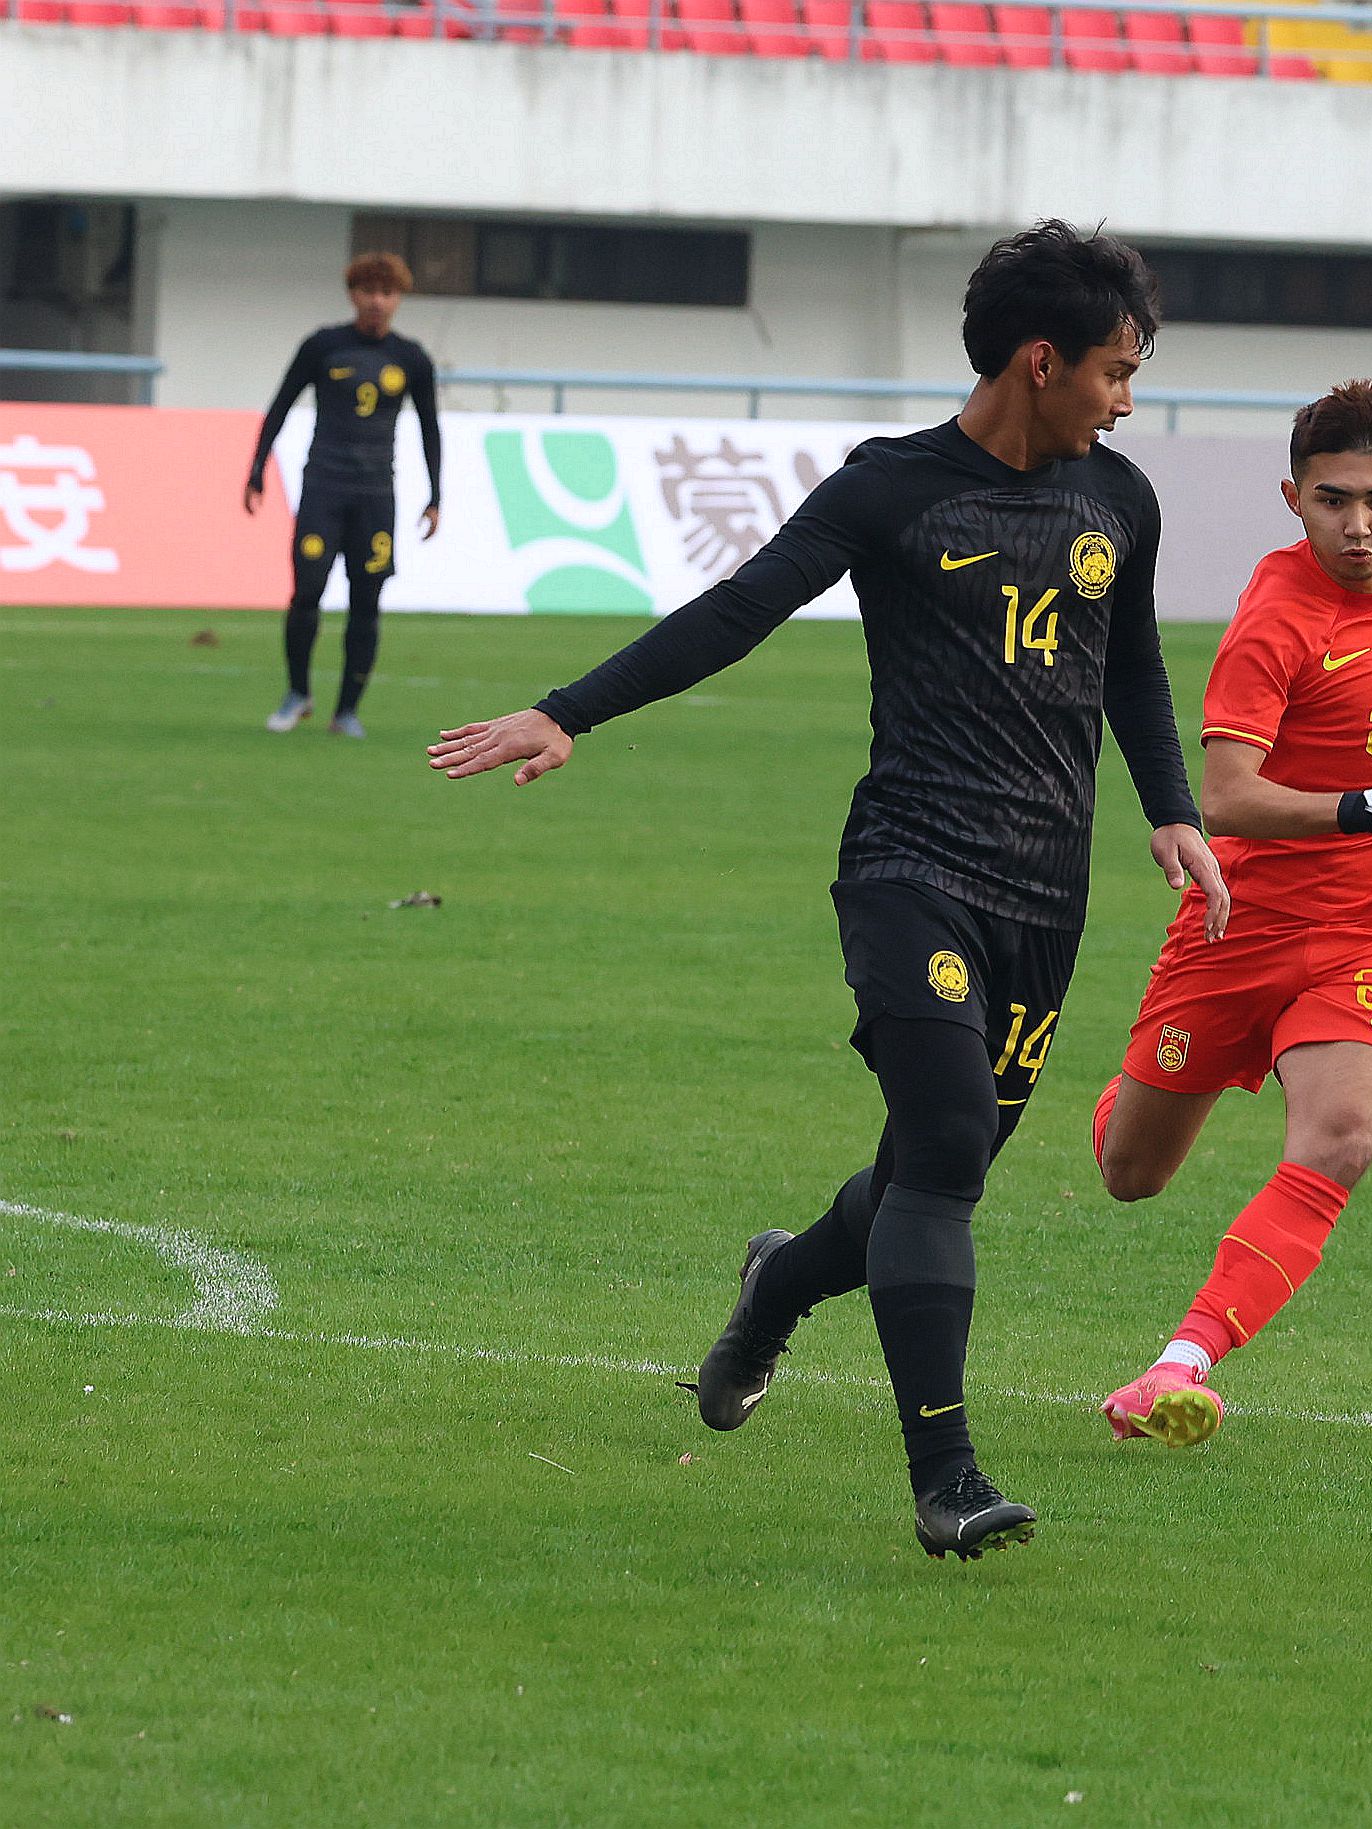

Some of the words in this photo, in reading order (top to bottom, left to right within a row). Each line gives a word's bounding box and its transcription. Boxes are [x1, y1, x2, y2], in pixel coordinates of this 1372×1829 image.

[355, 381, 379, 418] 9
[0, 434, 120, 574] 安
[364, 530, 393, 574] 9
[1001, 584, 1060, 667] 14
[993, 1002, 1058, 1084] 14
[1164, 1028, 1187, 1043] CFA
